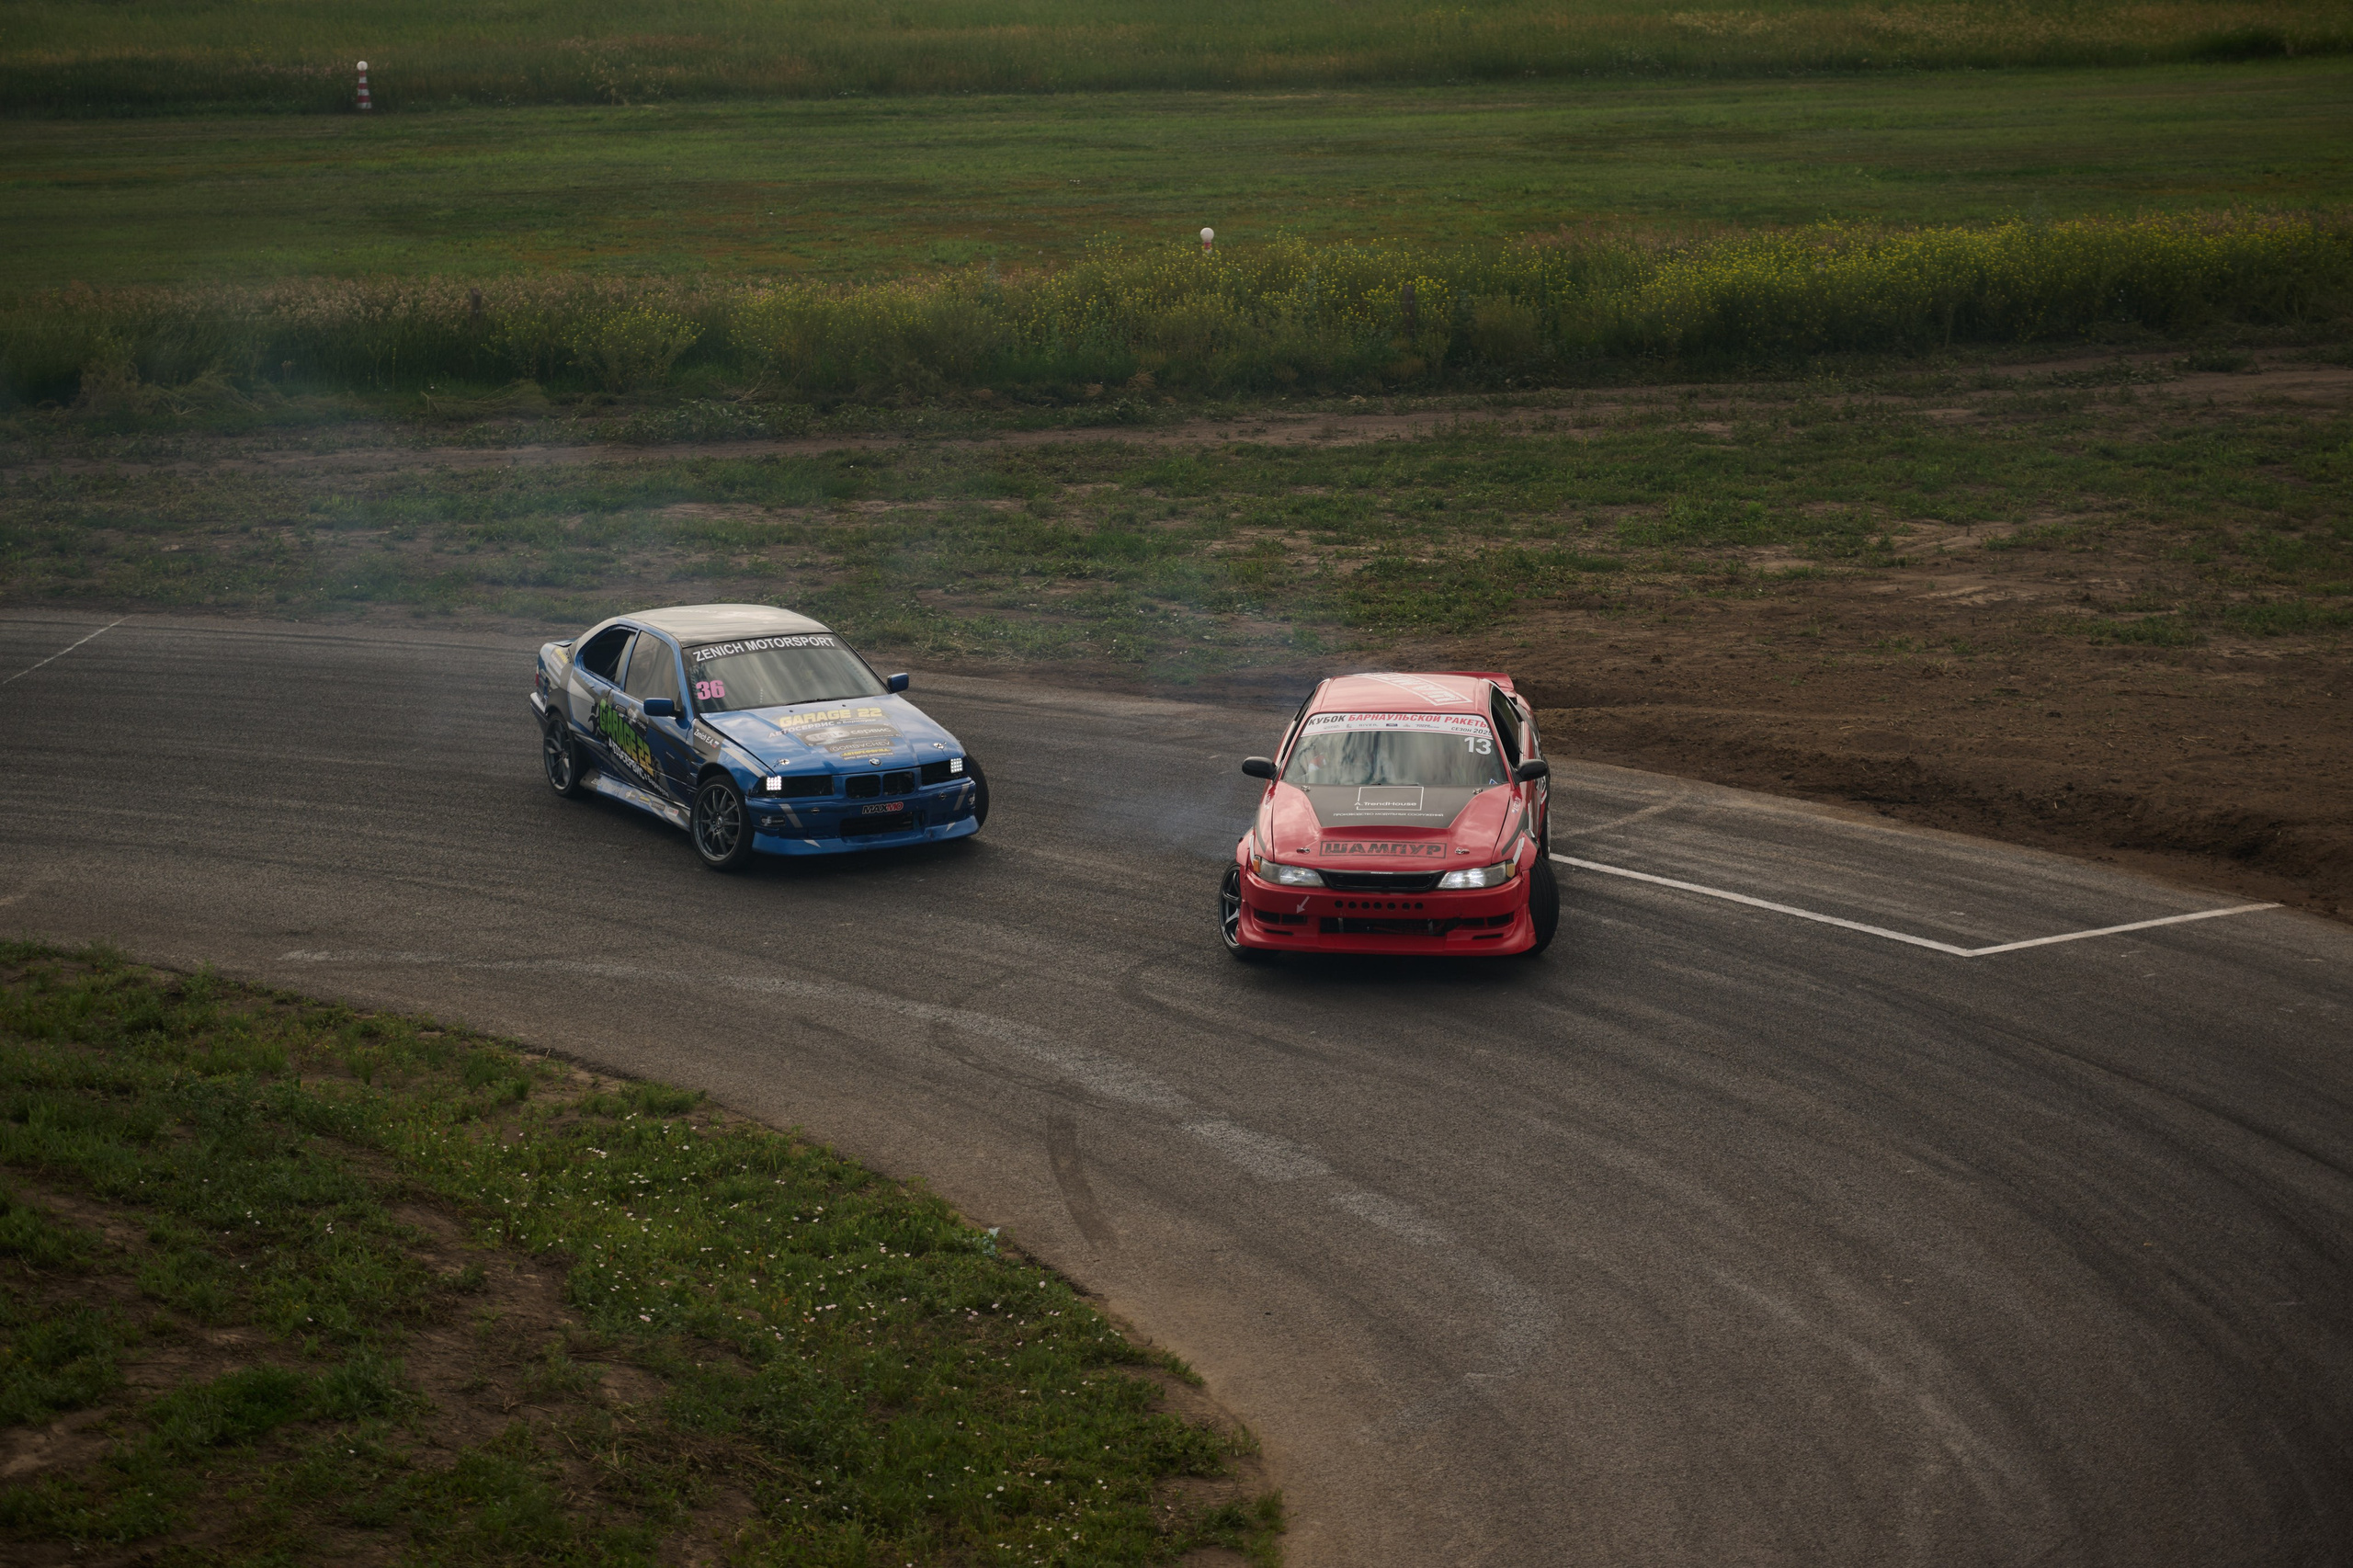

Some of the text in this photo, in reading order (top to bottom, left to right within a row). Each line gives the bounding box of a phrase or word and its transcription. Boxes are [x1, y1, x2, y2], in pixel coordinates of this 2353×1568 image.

[693, 636, 835, 663] ZENICH MOTORSPORT
[696, 680, 725, 700] 36
[779, 708, 882, 727] GARAGE 22
[1308, 715, 1347, 725] КУБОК
[1347, 713, 1441, 723] БАРНАУЛЬСКОЙ
[599, 699, 654, 777] GARAGE 22
[768, 721, 835, 738] АВТОСЕРВИС
[1464, 737, 1492, 756] 13
[862, 801, 904, 814] MAXMO
[1324, 843, 1442, 856] ШАМПУР
